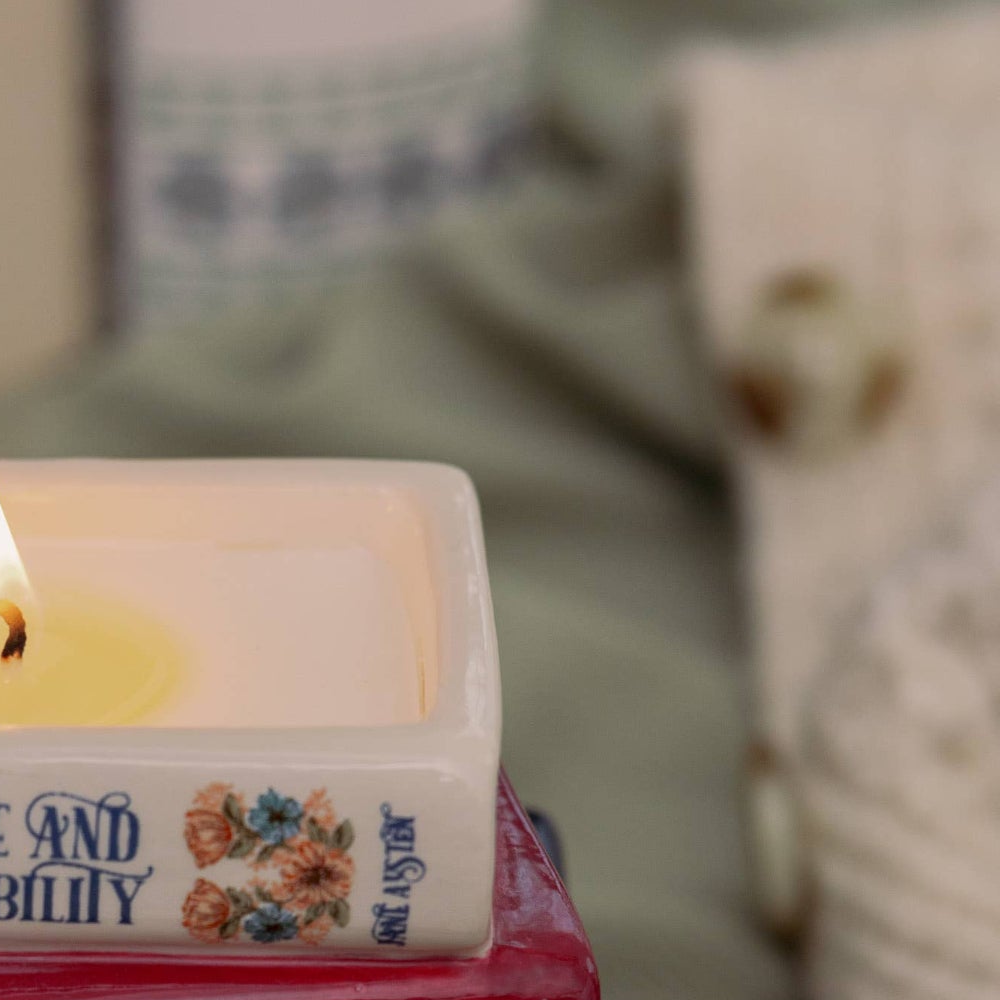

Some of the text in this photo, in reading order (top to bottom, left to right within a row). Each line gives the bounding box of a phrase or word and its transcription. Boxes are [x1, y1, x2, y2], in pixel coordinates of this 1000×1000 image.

[25, 792, 141, 862] AND
[371, 801, 427, 947] JANE AUSTEN
